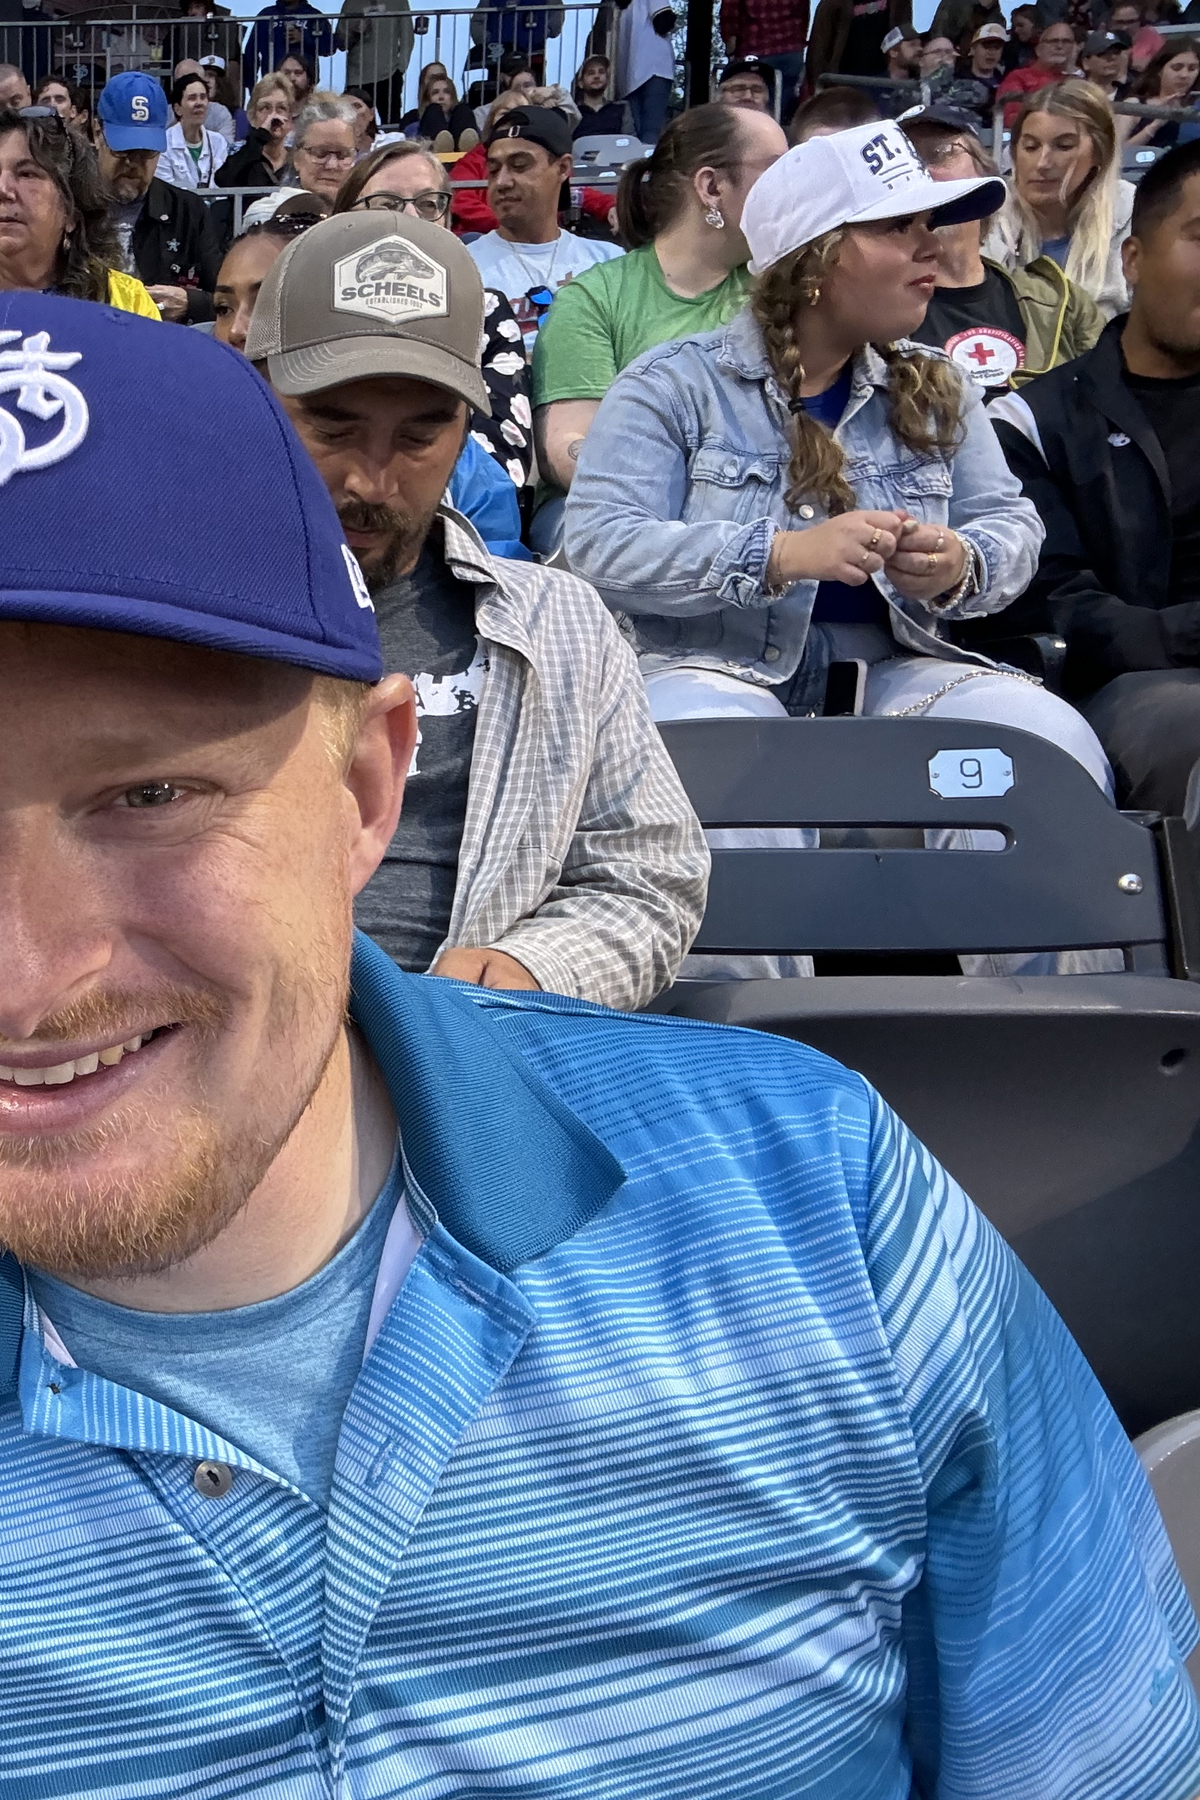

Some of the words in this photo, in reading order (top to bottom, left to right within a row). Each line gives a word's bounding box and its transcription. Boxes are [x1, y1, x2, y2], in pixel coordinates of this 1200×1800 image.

[860, 133, 902, 175] ST.
[341, 282, 441, 307] SCHEELS
[960, 758, 982, 789] 9
